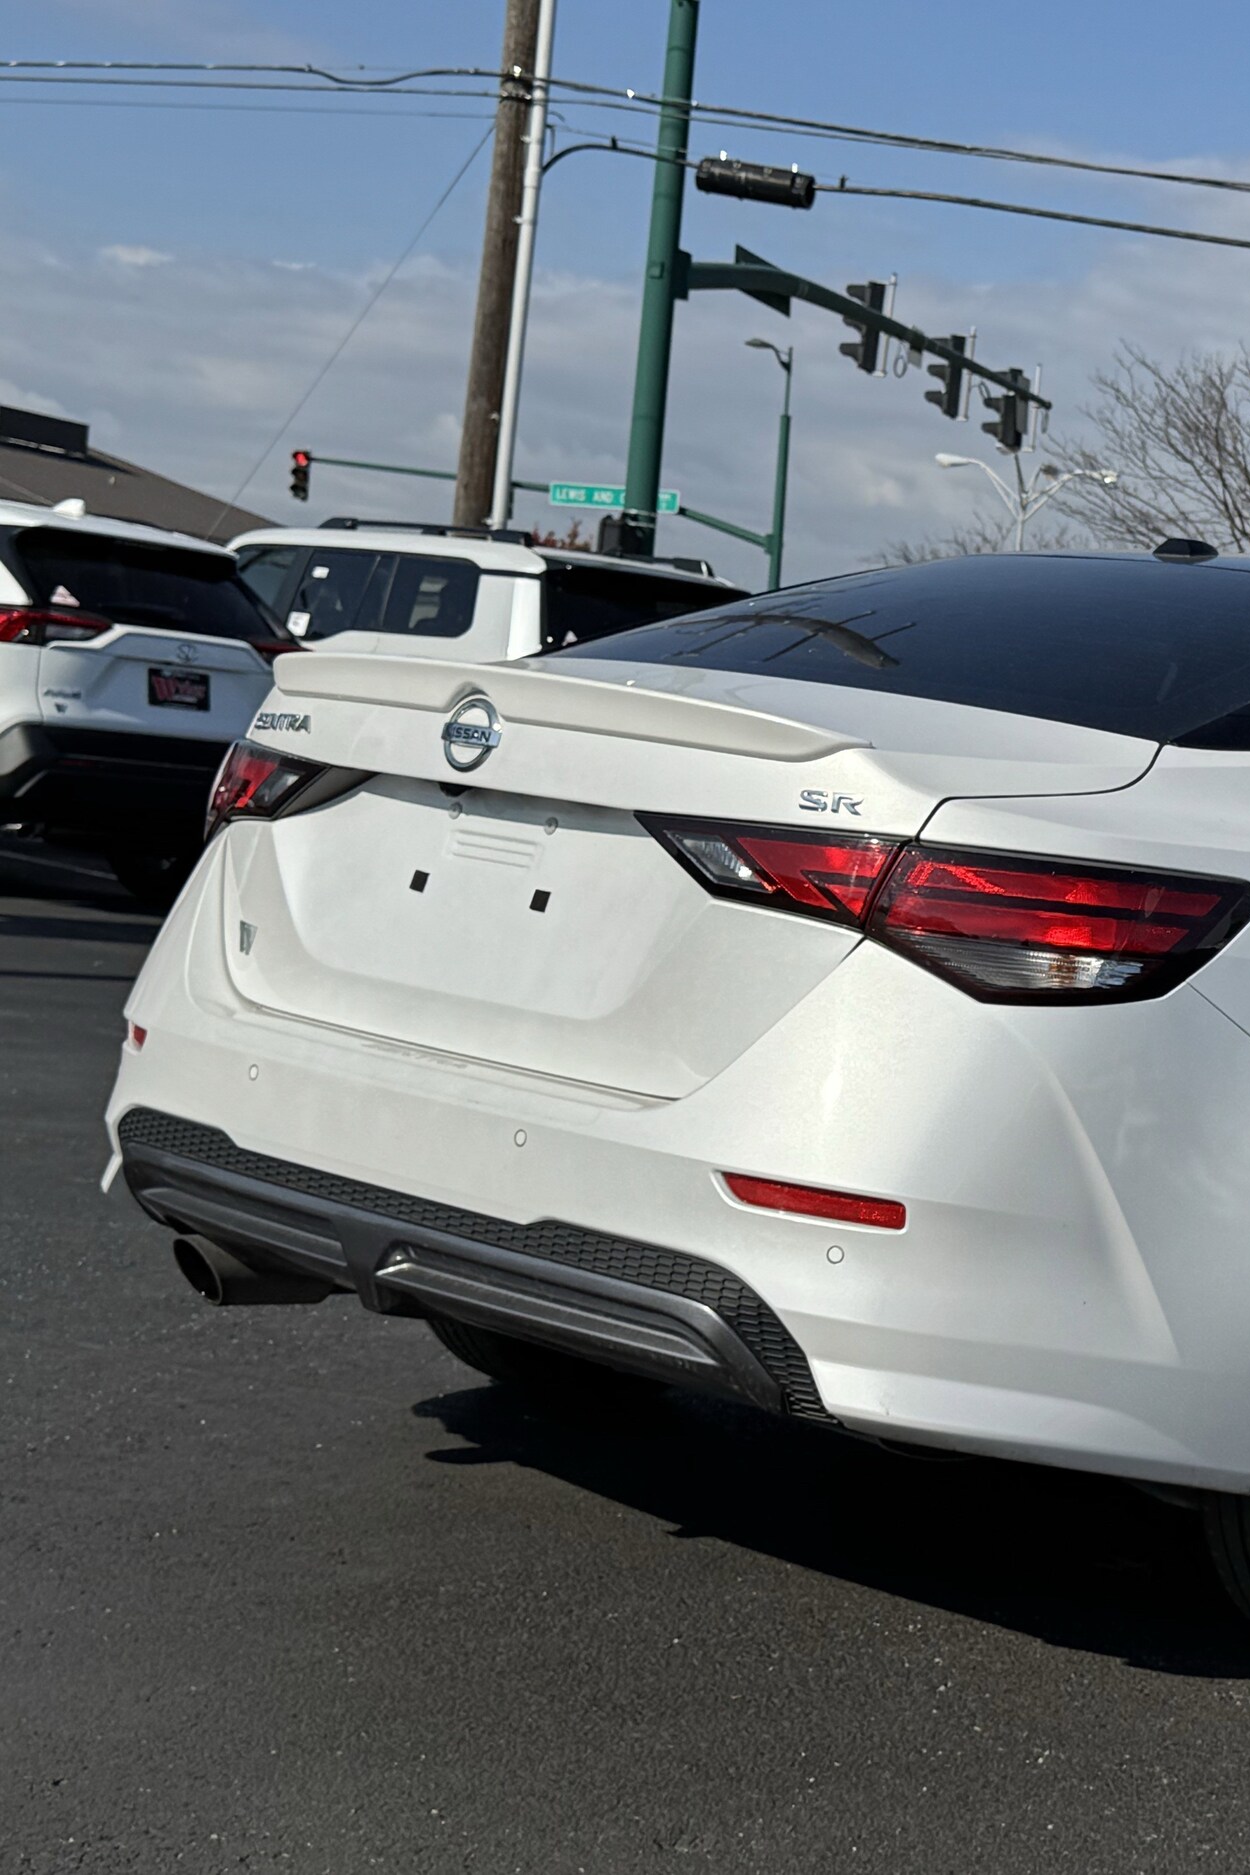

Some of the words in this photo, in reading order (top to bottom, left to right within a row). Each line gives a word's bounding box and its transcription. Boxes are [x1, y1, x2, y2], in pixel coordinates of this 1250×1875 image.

[556, 487, 586, 502] LEWIS
[592, 491, 614, 504] AND
[799, 789, 865, 816] SR
